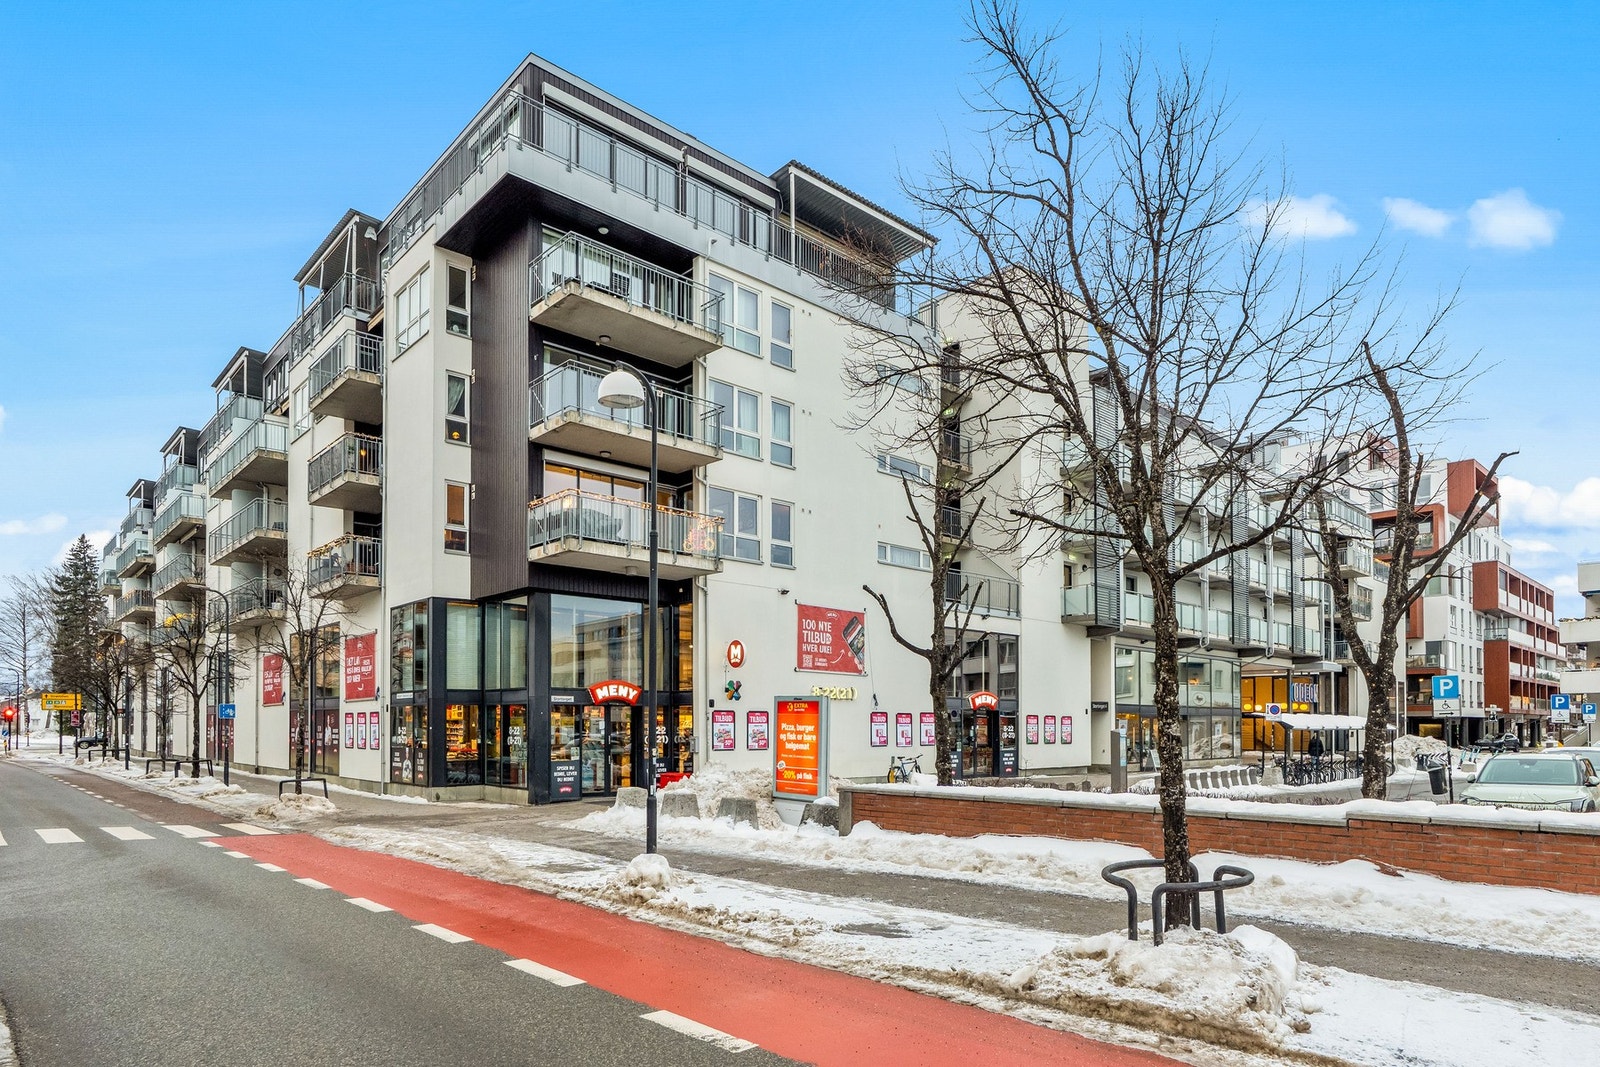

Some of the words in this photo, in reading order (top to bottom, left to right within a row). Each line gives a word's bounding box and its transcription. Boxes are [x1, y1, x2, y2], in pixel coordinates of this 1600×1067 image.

[802, 619, 817, 630] 100
[818, 621, 832, 632] NYE
[802, 631, 832, 645] TILBUD
[802, 643, 818, 653] HVER
[595, 684, 638, 700] MENY
[1291, 682, 1318, 703] ODEON
[1439, 679, 1453, 696] P
[974, 695, 998, 706] MENY
[1555, 696, 1565, 708] P
[1585, 705, 1593, 713] P
[781, 723, 796, 732] Pizza,
[796, 724, 815, 733] burger
[779, 733, 787, 741] og
[787, 732, 797, 740] fisk
[803, 733, 817, 741] bare
[785, 741, 810, 751] helgemat
[803, 772, 813, 780] fisk
